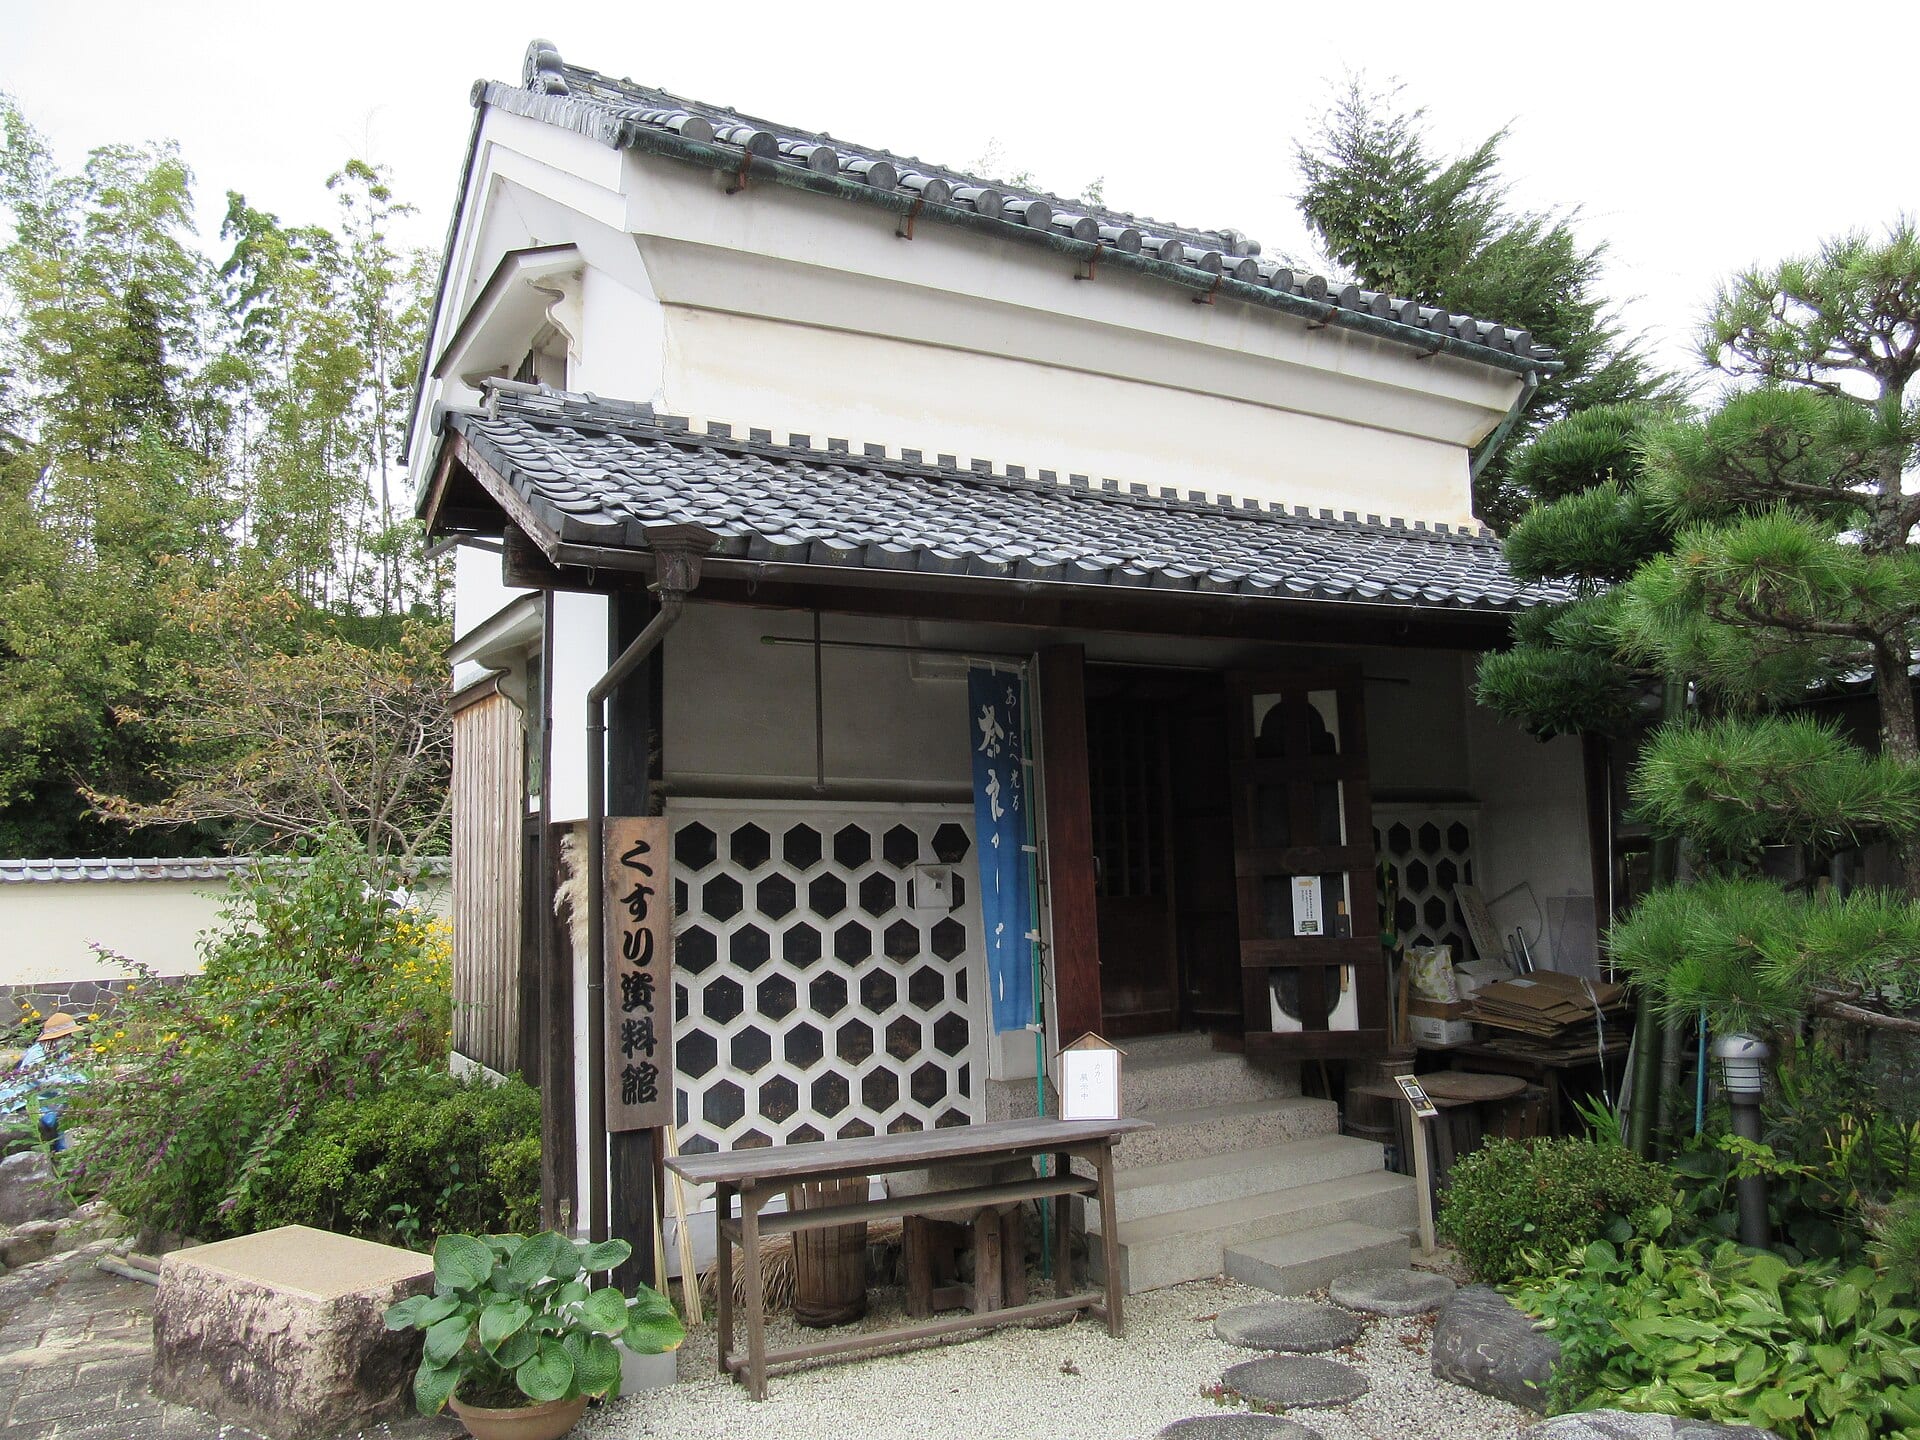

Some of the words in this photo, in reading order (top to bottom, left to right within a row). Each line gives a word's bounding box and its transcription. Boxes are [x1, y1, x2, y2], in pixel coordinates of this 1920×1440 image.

[620, 840, 659, 1105] くすり資料館
